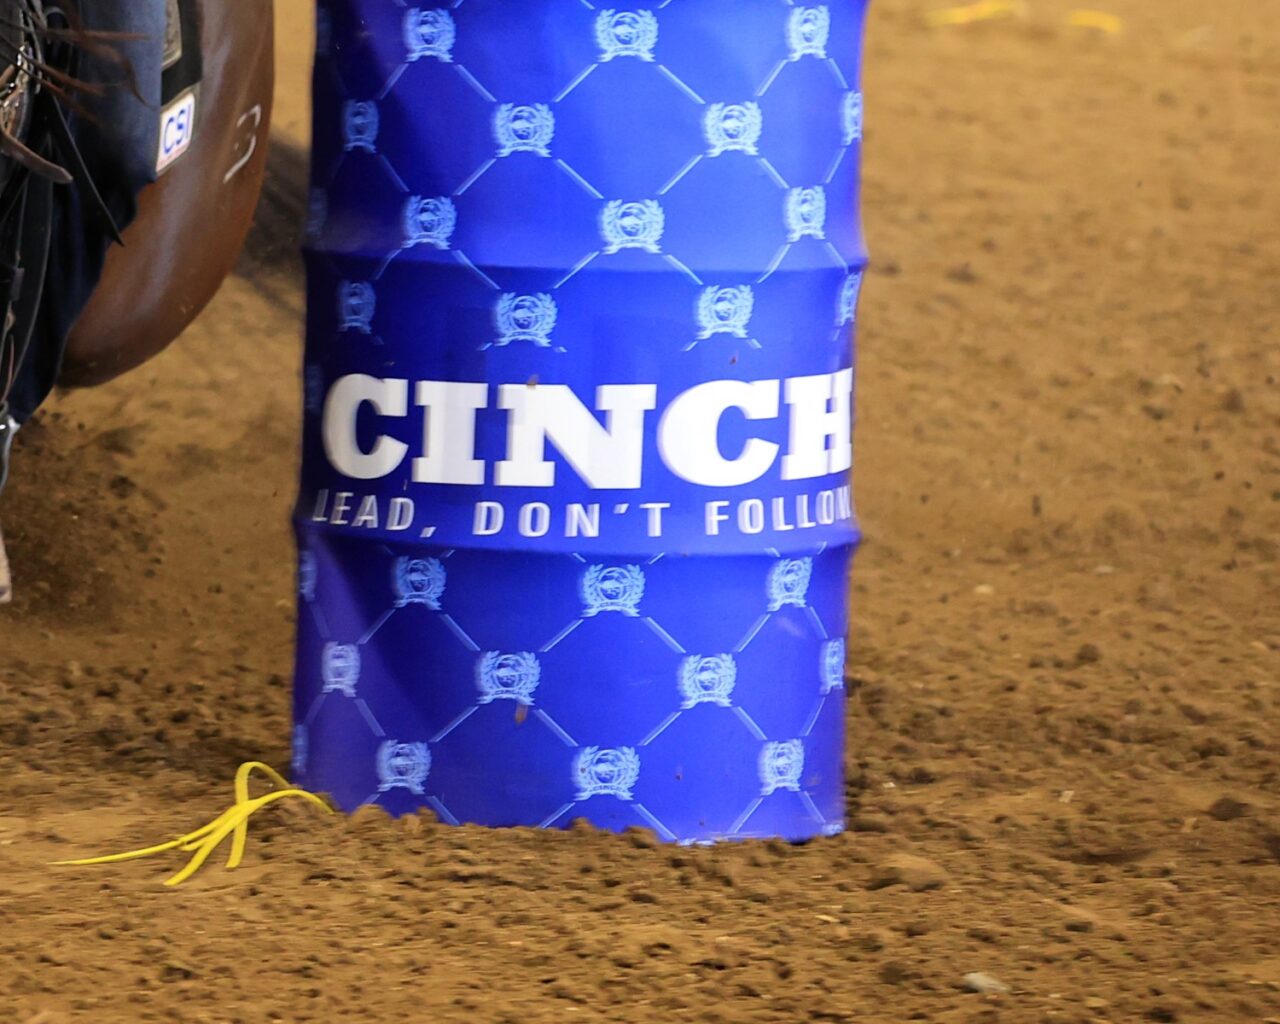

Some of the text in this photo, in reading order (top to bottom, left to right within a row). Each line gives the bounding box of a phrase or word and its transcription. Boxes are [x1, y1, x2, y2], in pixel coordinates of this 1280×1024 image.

[322, 367, 852, 489] CINCH
[312, 488, 436, 538] LEAD,
[472, 500, 671, 538] DON'T
